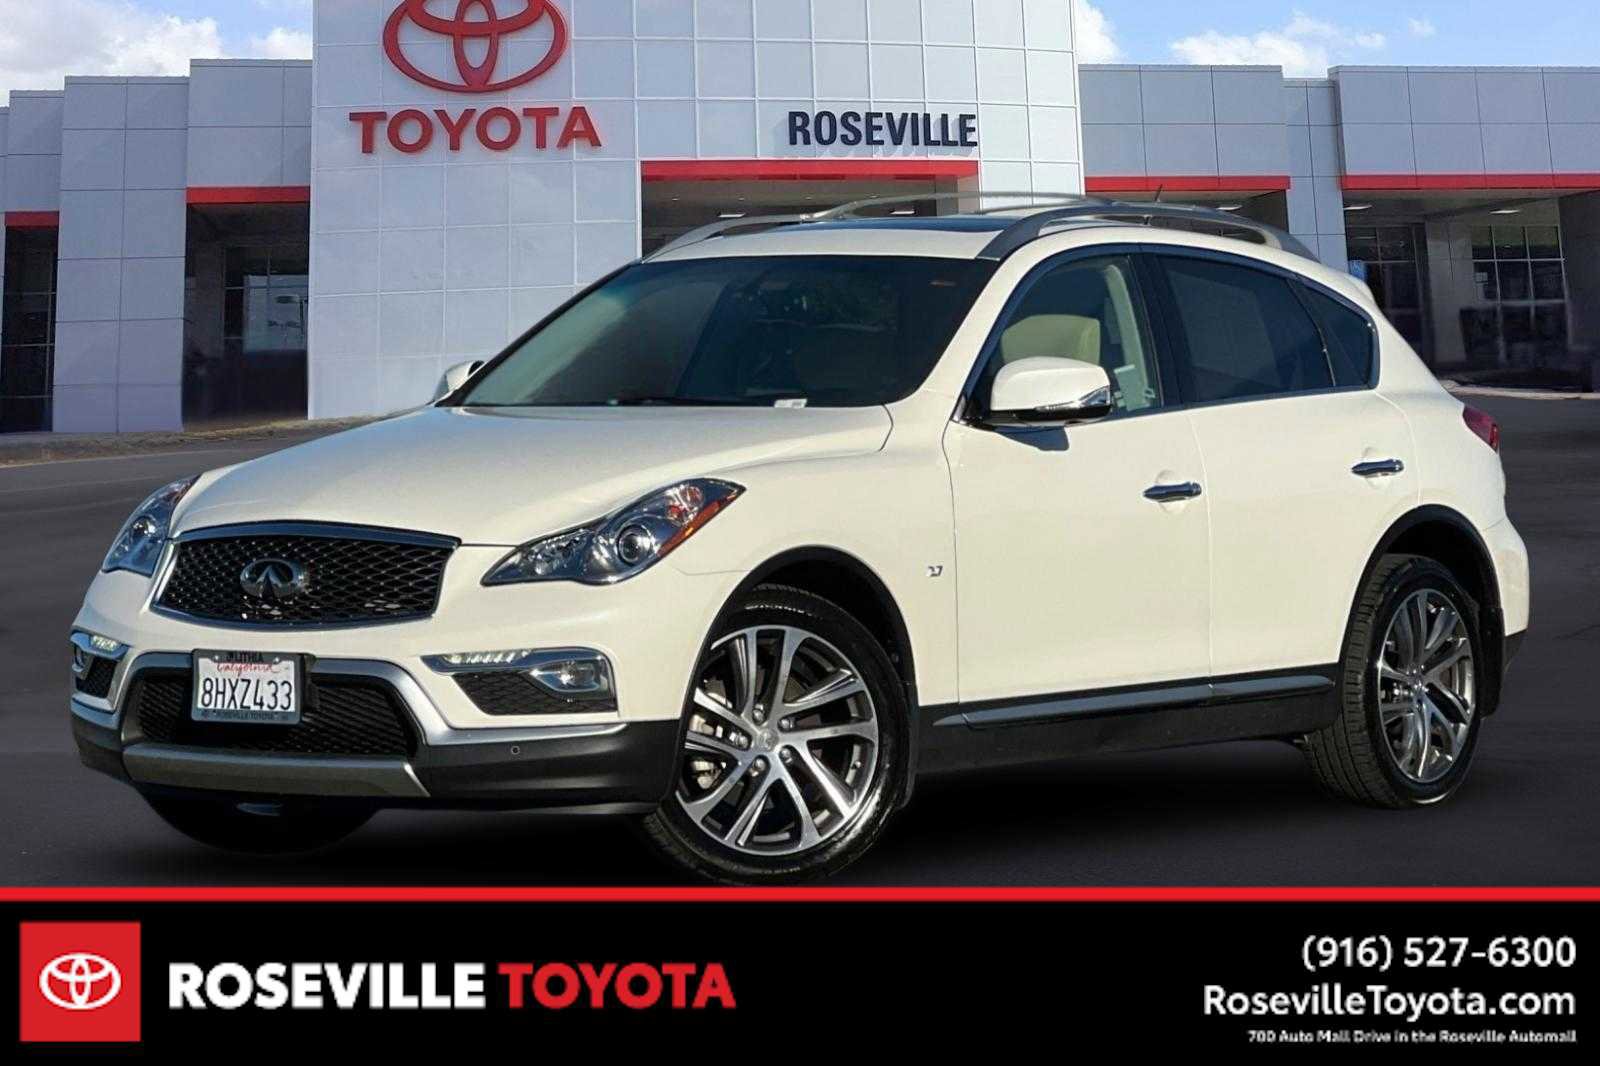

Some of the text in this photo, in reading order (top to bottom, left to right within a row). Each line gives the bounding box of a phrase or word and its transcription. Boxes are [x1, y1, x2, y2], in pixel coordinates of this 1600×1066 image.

[349, 106, 602, 154] TOYOTA
[788, 111, 978, 147] ROSEVILLE
[216, 662, 275, 676] California
[201, 677, 292, 710] 8HXZ433
